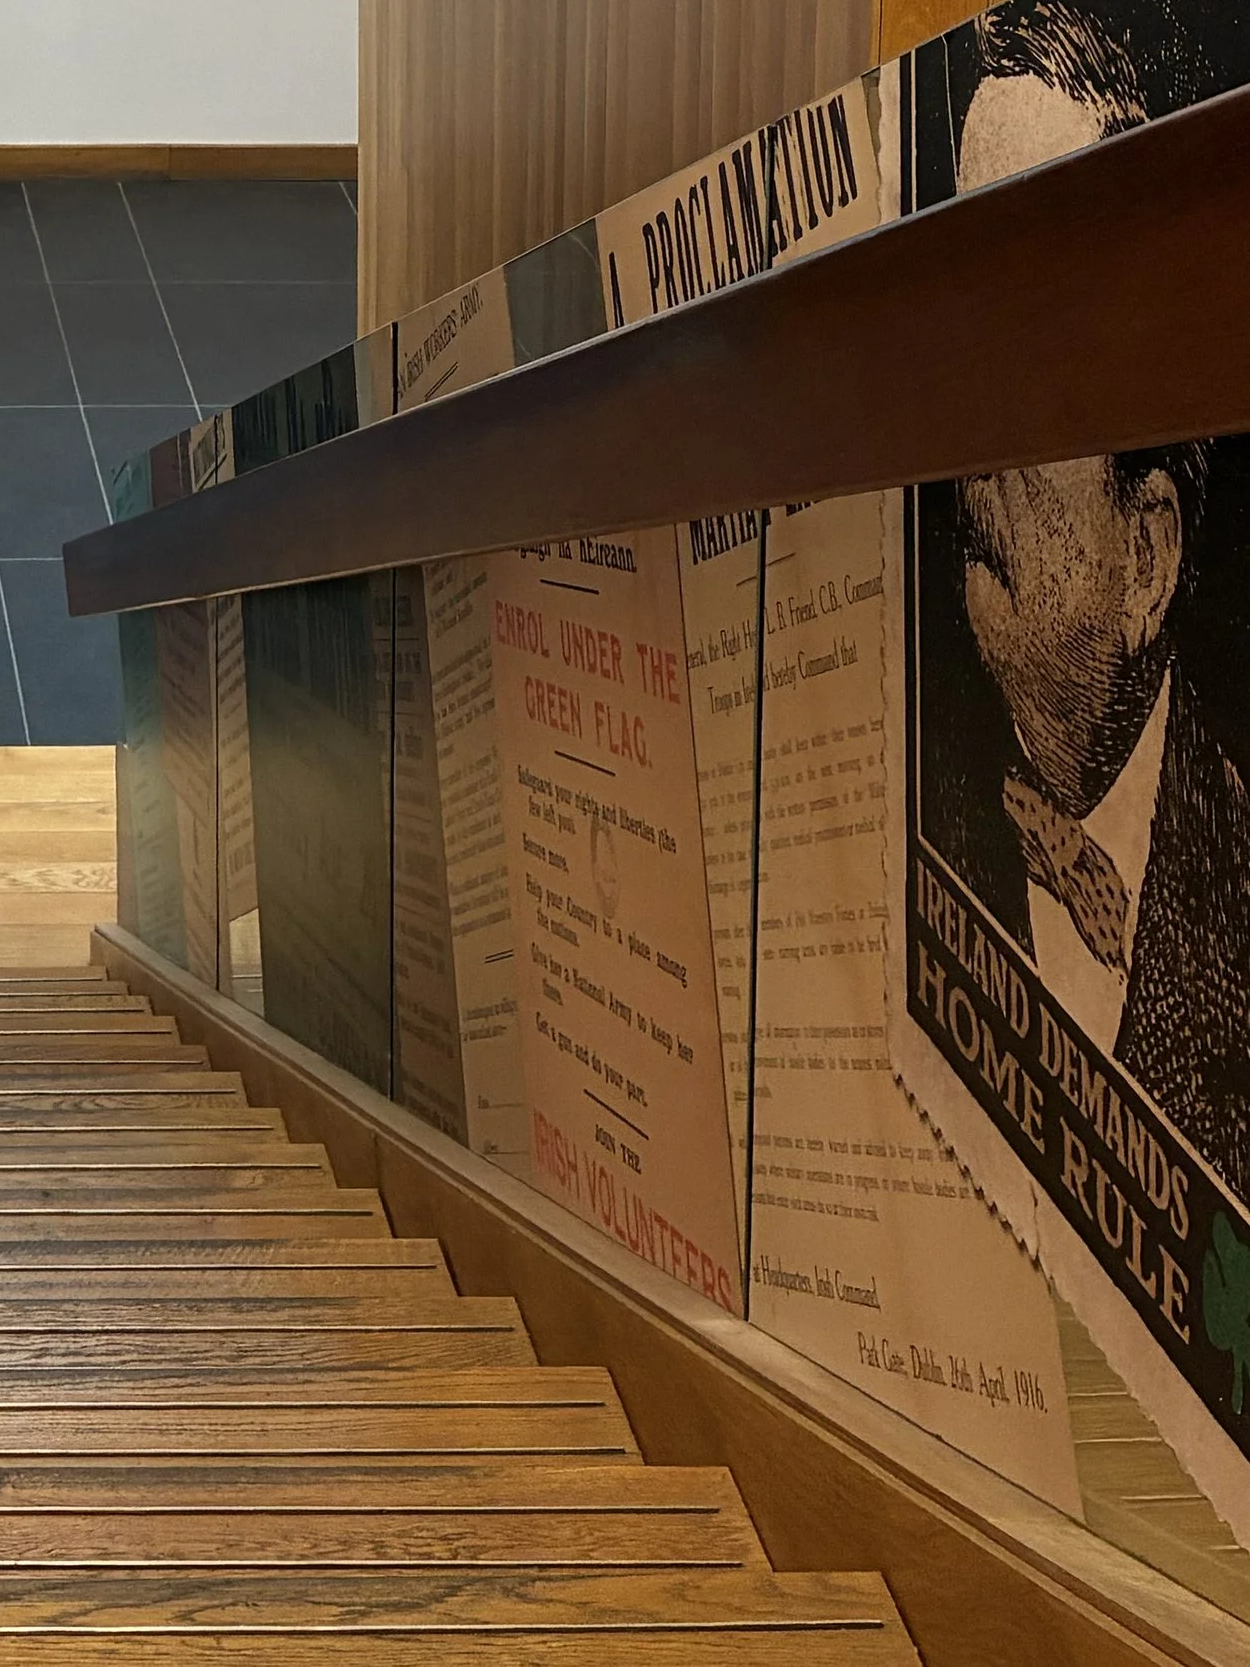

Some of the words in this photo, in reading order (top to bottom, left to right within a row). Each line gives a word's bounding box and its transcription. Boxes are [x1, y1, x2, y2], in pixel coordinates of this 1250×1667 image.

[642, 93, 858, 314] PROCLAMATION
[494, 599, 550, 659] ENROL
[559, 619, 625, 684] UNDER
[635, 642, 681, 706] THE
[523, 675, 583, 740] GREEN
[593, 699, 653, 769] FLAG.
[915, 856, 1030, 1040] IRELAND
[1039, 1002, 1189, 1241] DEMANDS
[533, 1106, 581, 1200] IRISH
[620, 1142, 642, 1175] THE
[915, 940, 1047, 1155] HOME
[1059, 1116, 1191, 1345] RULE
[1013, 1369, 1048, 1413] 1916.
